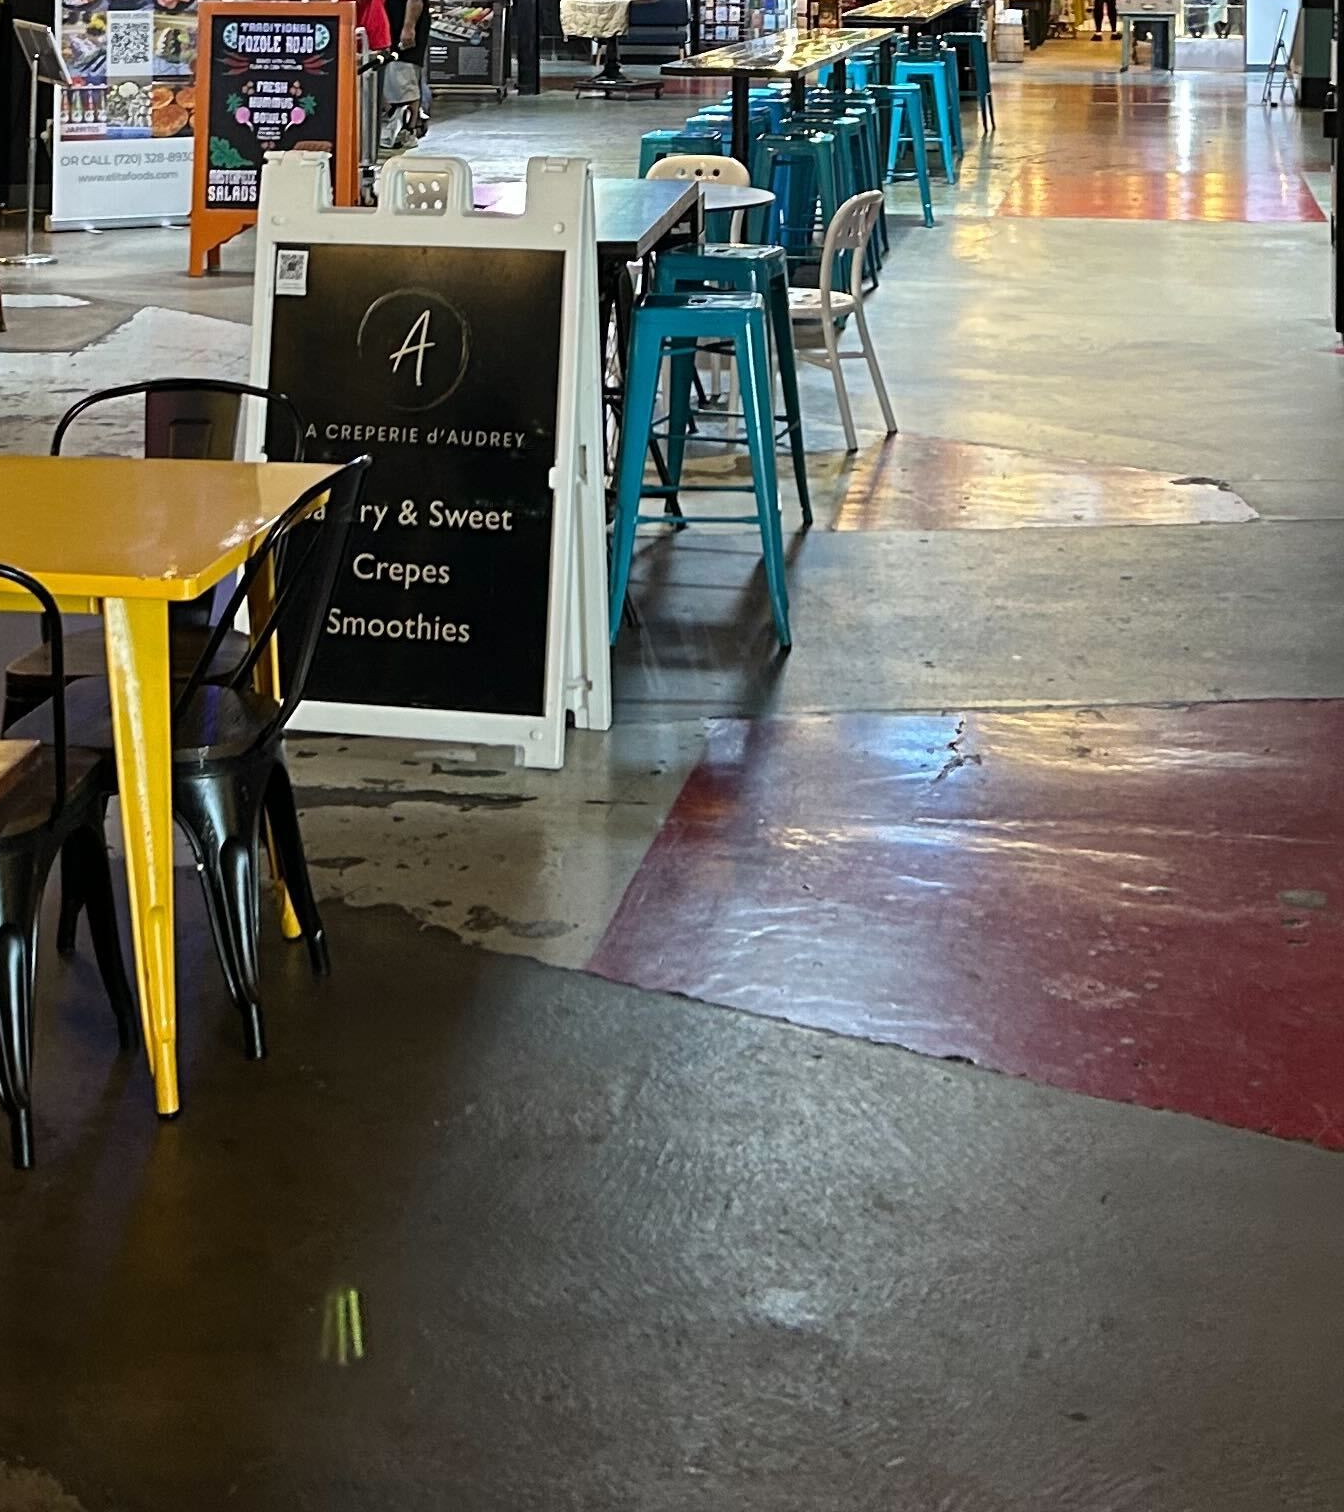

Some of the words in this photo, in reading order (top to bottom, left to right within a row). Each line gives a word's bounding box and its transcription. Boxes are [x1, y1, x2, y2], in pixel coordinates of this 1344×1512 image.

[240, 22, 315, 34] TRADITIONAL
[237, 35, 282, 53] POZOLE
[285, 36, 314, 54] ROJO
[256, 80, 289, 94] FRESH
[60, 155, 79, 167] OR
[81, 154, 111, 166] CALL
[113, 152, 142, 167] (720)
[207, 185, 257, 202] SALADS
[389, 309, 436, 387] A
[305, 423, 317, 439] A
[325, 423, 420, 444] CREPERIE
[426, 427, 526, 449] d'AUDREY
[397, 499, 419, 527] &
[428, 500, 514, 532] Sweet
[352, 552, 451, 591] Crepes
[326, 607, 472, 644] Smoothies
